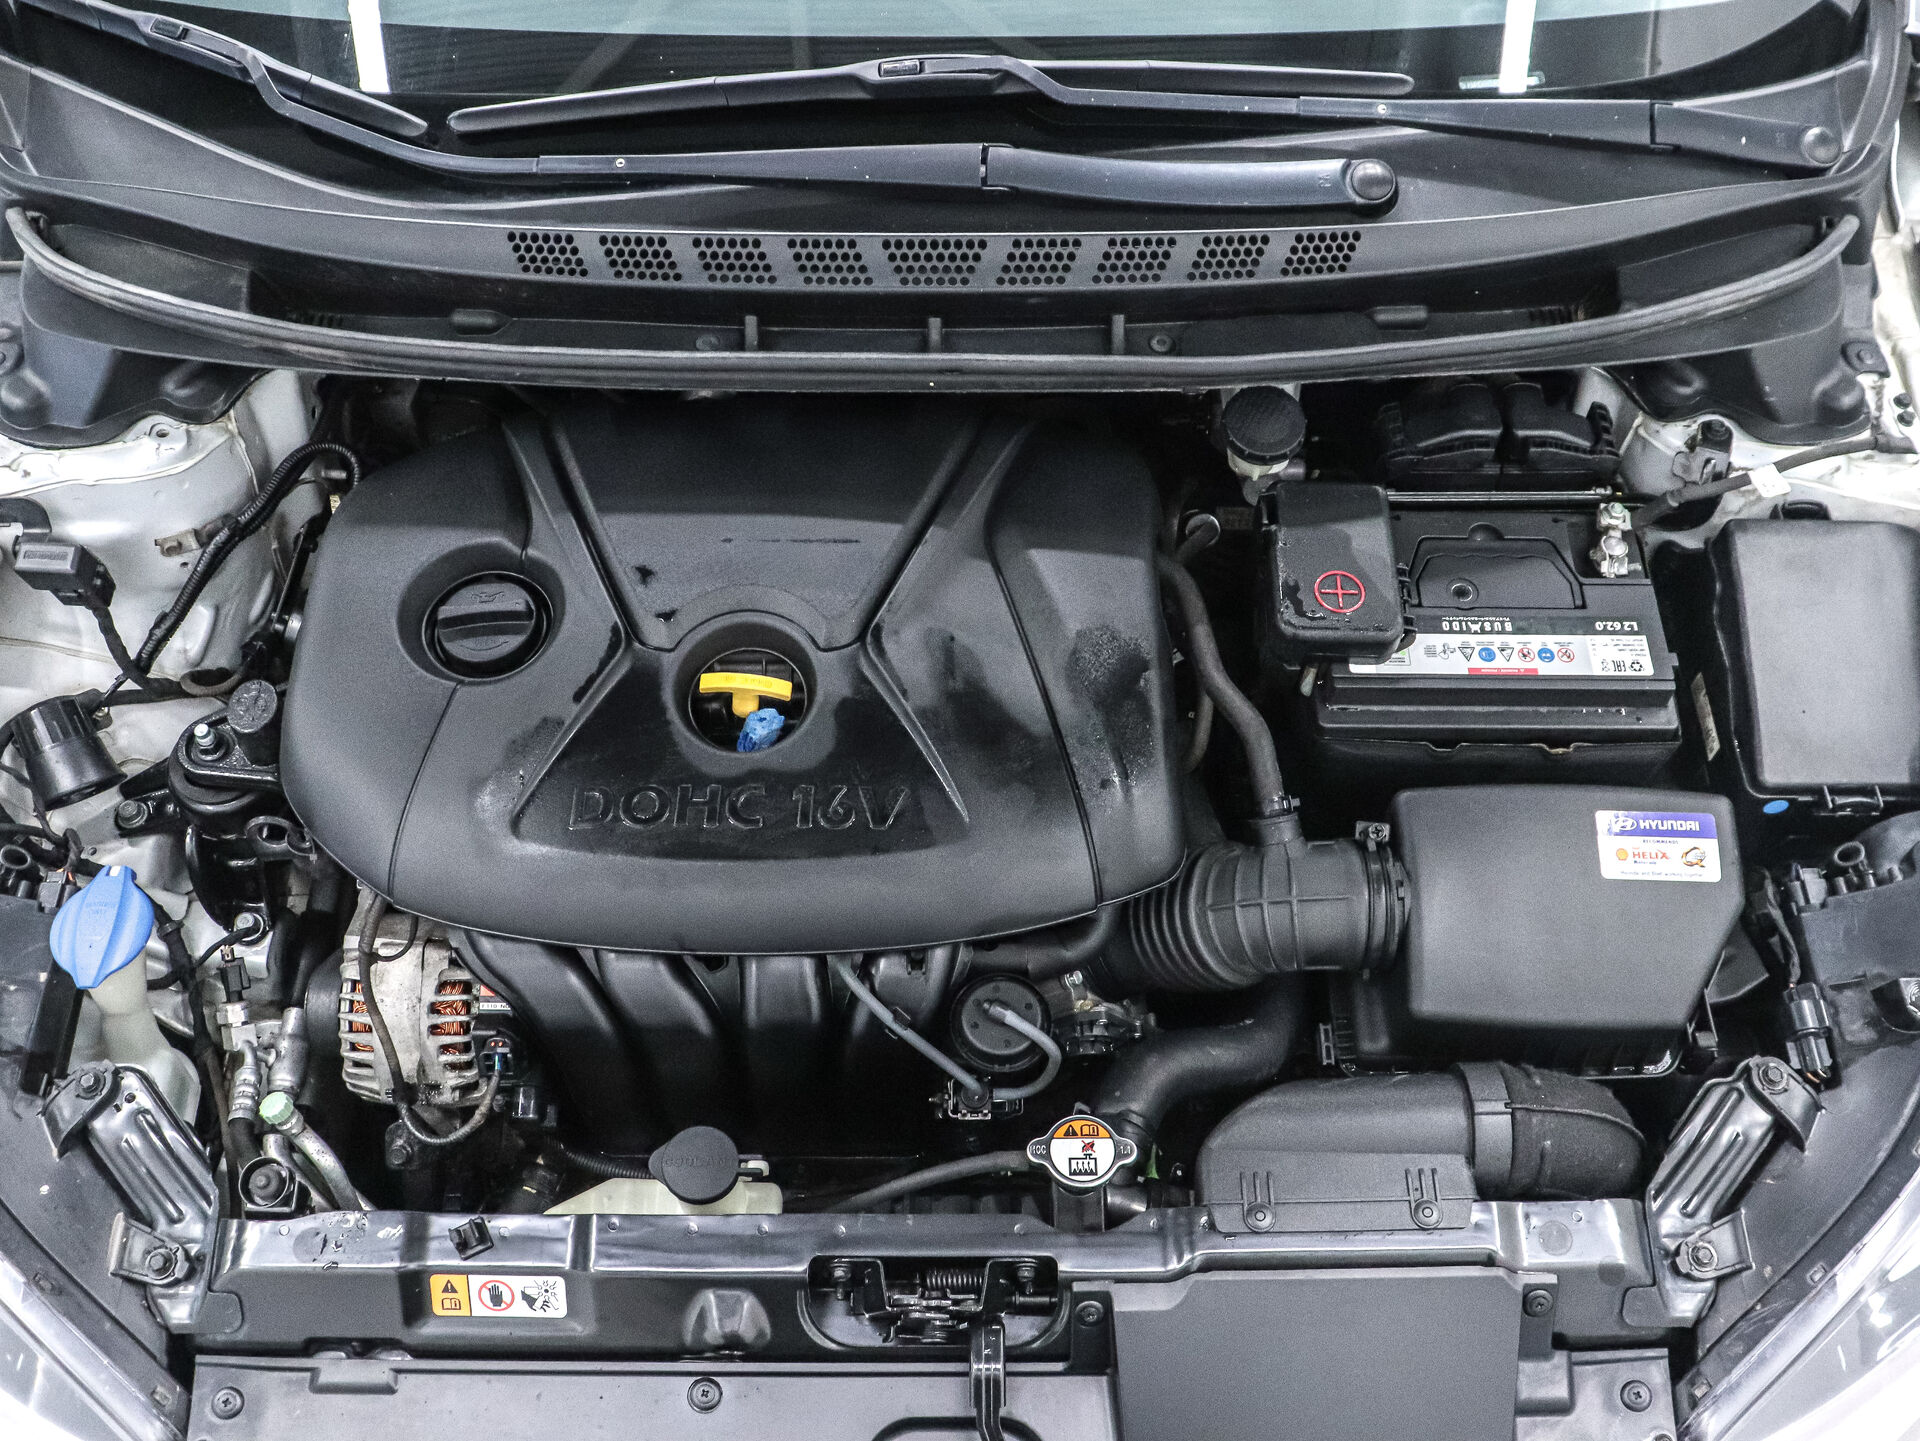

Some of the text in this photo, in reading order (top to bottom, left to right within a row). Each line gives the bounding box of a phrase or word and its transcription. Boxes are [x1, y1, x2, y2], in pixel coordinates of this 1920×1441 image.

[1595, 621, 1638, 631] L2 62.0
[568, 783, 911, 830] DOHC 16V
[1639, 819, 1700, 831] HYUNDAI
[1632, 849, 1670, 860] HELIX
